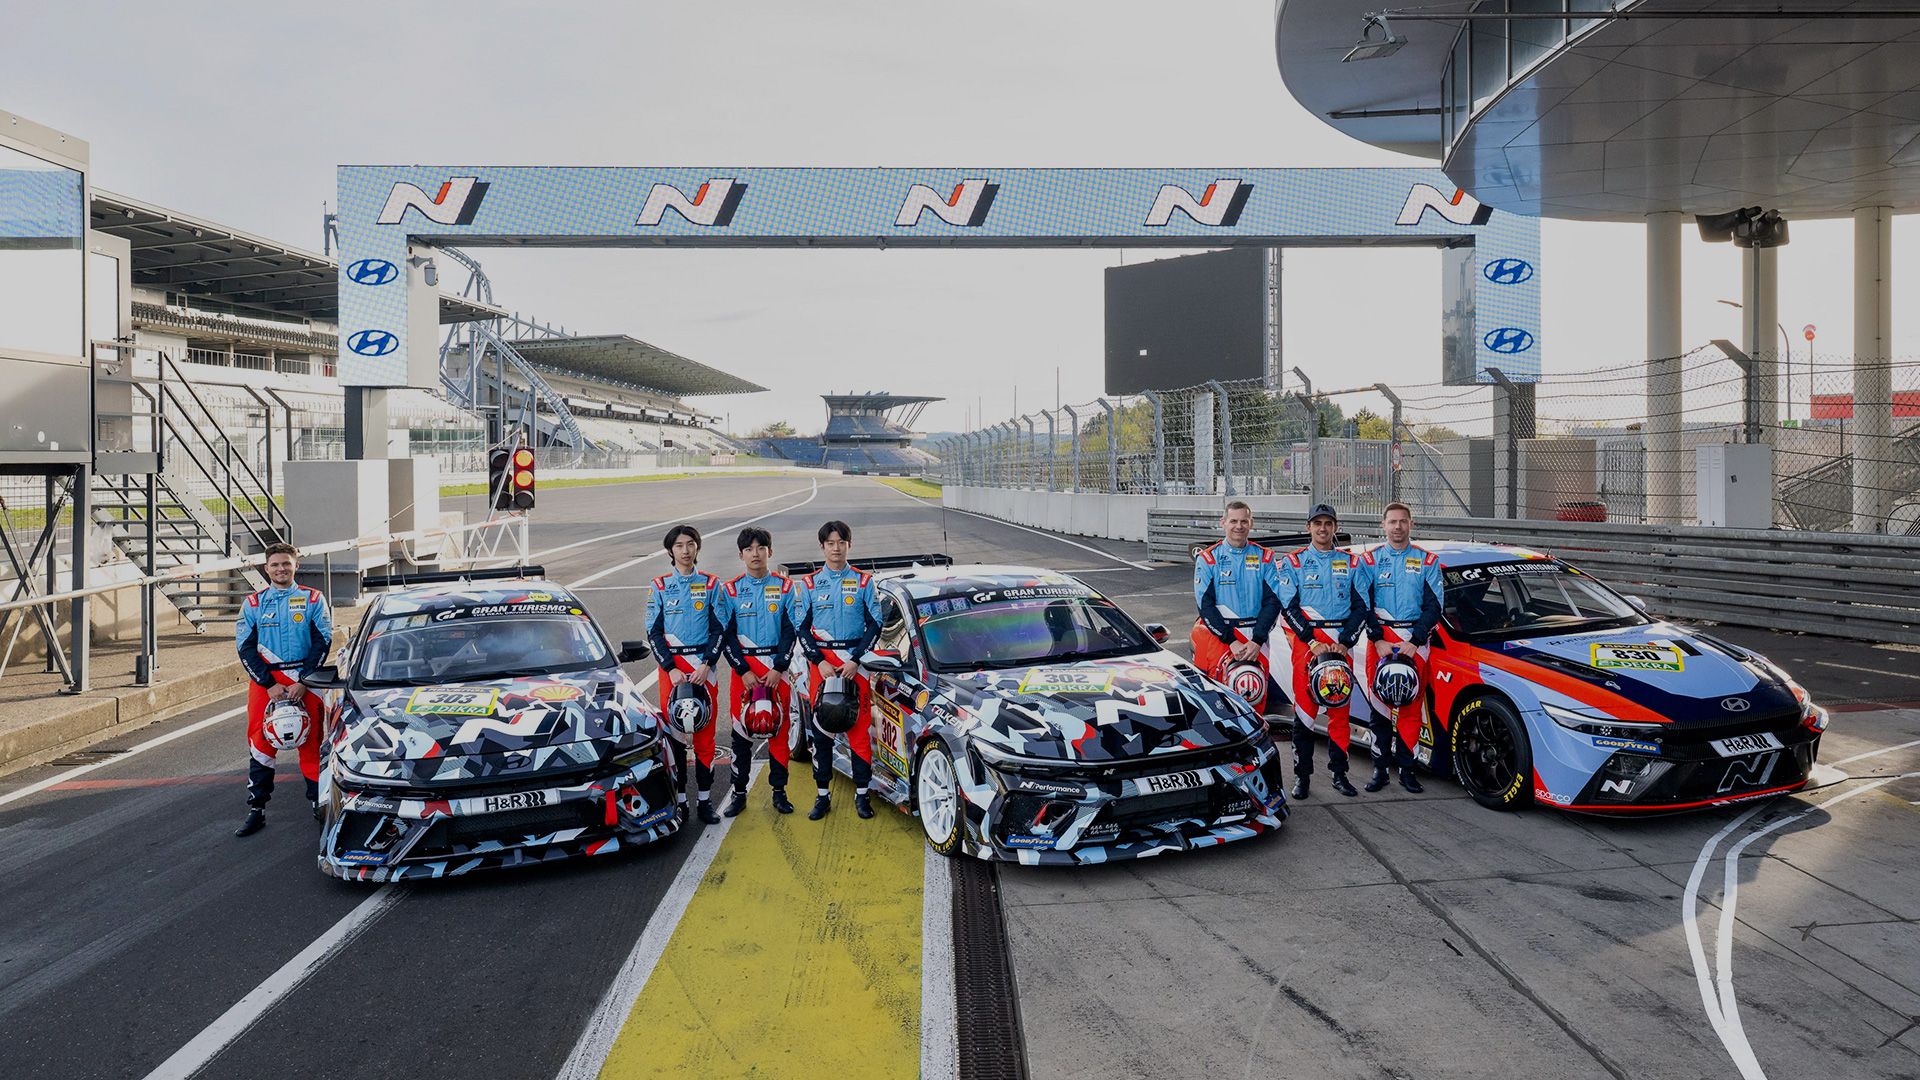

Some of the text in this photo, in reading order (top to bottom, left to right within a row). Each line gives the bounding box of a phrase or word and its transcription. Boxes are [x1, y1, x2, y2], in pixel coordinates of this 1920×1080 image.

[1487, 564, 1517, 574] GRAN
[1517, 563, 1560, 573] TURISMO
[1003, 588, 1036, 597] GRAN
[1038, 587, 1086, 596] TURISMO
[471, 606, 508, 615] GRAN
[511, 605, 567, 613] TURISMO
[1612, 649, 1661, 661] 830
[1620, 661, 1674, 671] DEKRA
[1043, 674, 1090, 684] 302
[1046, 684, 1100, 692] DEKRA
[429, 694, 474, 704] 303
[437, 706, 487, 714] DEKRA
[881, 718, 898, 752] 302
[1595, 739, 1657, 752] GOODYEAR
[1036, 783, 1080, 794] Performance
[1503, 773, 1524, 803] EAGLE
[1535, 788, 1571, 802] sparco
